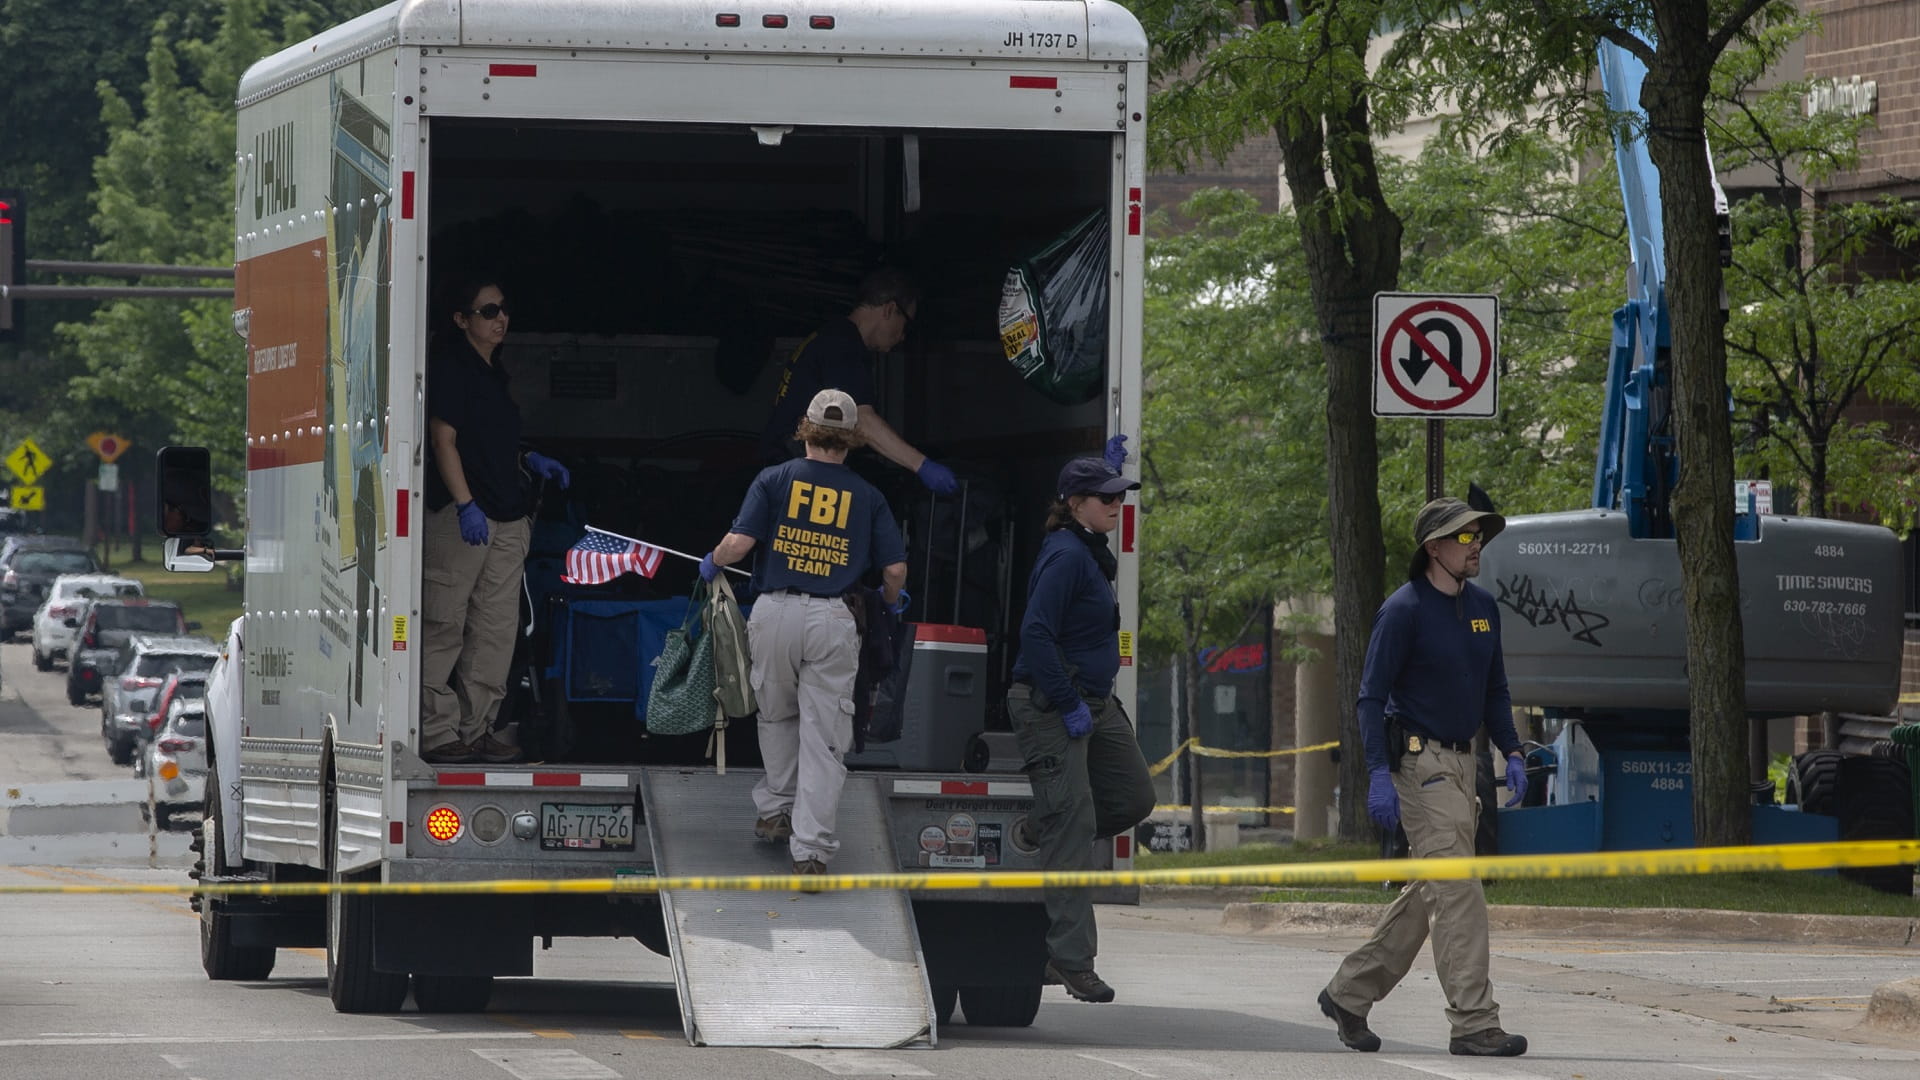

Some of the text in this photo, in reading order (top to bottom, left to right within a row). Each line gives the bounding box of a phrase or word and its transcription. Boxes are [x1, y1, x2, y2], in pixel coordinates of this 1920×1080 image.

[1003, 31, 1078, 49] JH 1737 D
[254, 120, 297, 221] U-HAUL
[787, 480, 852, 529] FBI
[777, 524, 849, 551] EVIDENCE
[772, 538, 849, 567] RESPONSE
[1517, 543, 1610, 555] S60X11-22711
[1813, 544, 1845, 558] 4884
[786, 555, 831, 578] TEAM
[1775, 574, 1873, 594] TIME SAVERS
[1783, 600, 1867, 615] 630-782-7666
[1470, 618, 1490, 633] FBI
[1621, 761, 1693, 775] S60X11-22
[1650, 777, 1685, 791] 4884
